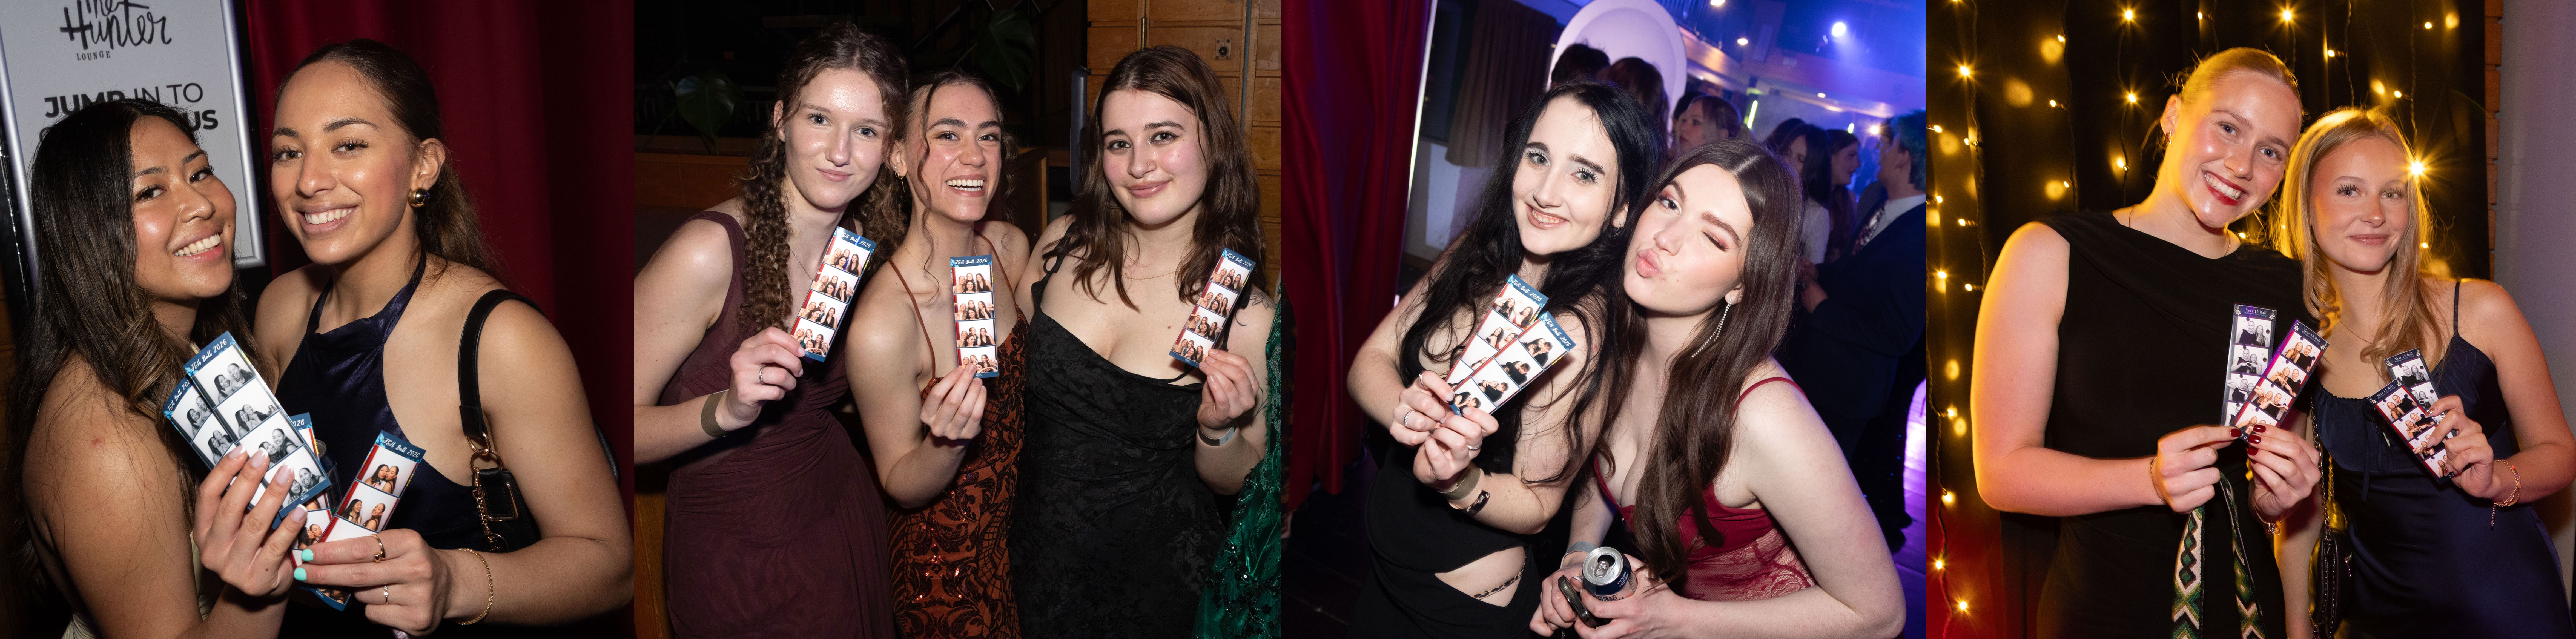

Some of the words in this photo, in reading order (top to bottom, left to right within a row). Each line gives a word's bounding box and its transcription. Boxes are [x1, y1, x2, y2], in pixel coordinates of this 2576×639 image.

[60, 0, 172, 50] Hunter
[76, 51, 111, 61] LOUNGE
[44, 91, 125, 118] JUMP
[134, 86, 160, 105] IN
[166, 83, 203, 104] TO
[1529, 292, 1542, 301] 2026
[1552, 328, 1562, 336] Ball
[1560, 336, 1571, 346] 2026
[202, 350, 212, 362] Ball
[213, 339, 227, 353] 2026
[182, 379, 191, 391] 202
[395, 445, 407, 453] Ball
[407, 449, 420, 458] 2026
